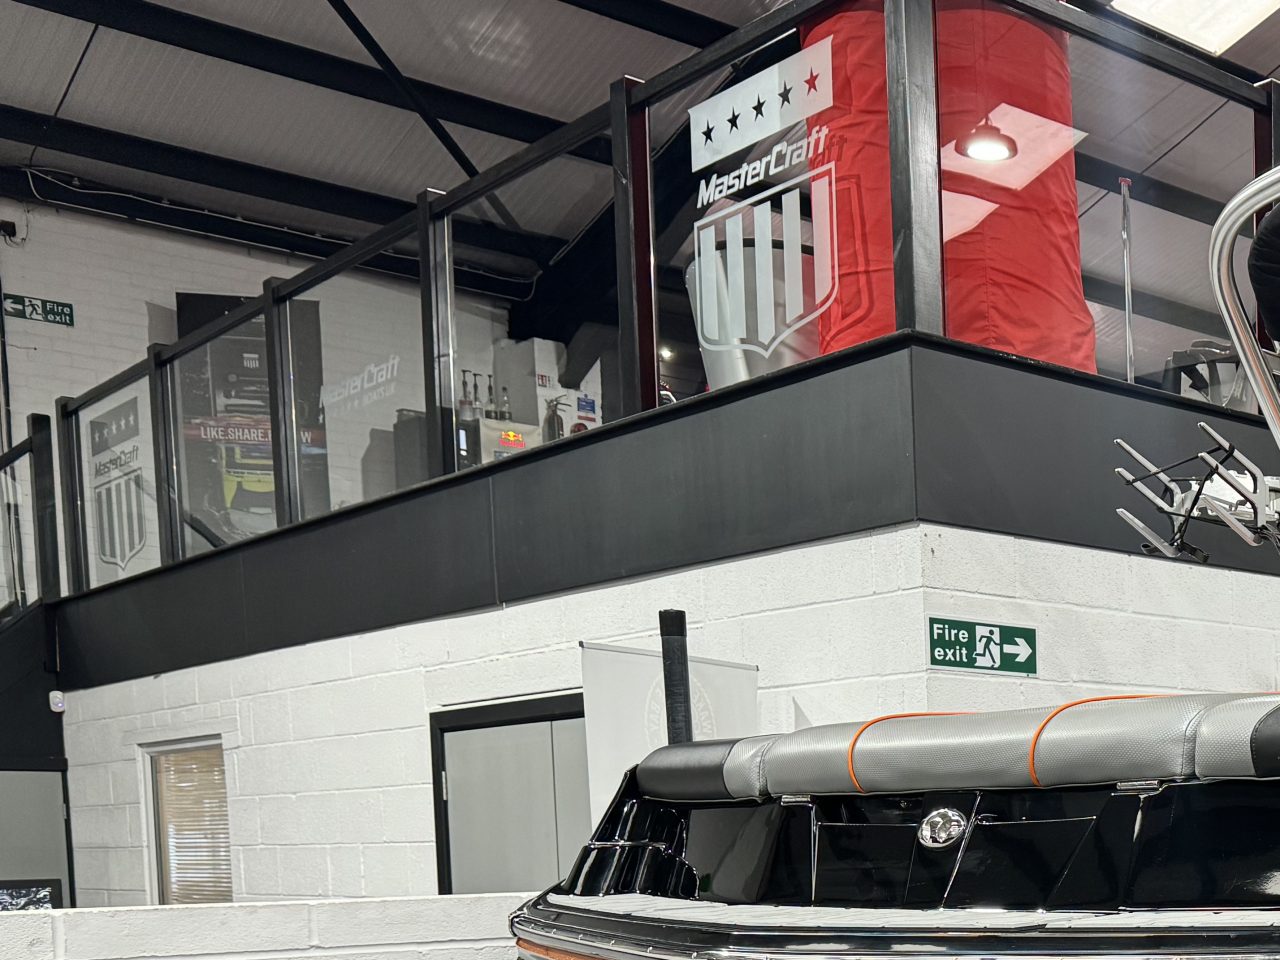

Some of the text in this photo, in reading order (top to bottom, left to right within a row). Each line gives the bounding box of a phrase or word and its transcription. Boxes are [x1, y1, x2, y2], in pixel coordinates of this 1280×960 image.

[697, 125, 829, 208] MasterCraft
[46, 302, 71, 314] Fire
[47, 313, 71, 324] exit
[933, 623, 969, 643] Fire
[934, 645, 968, 662] exit
